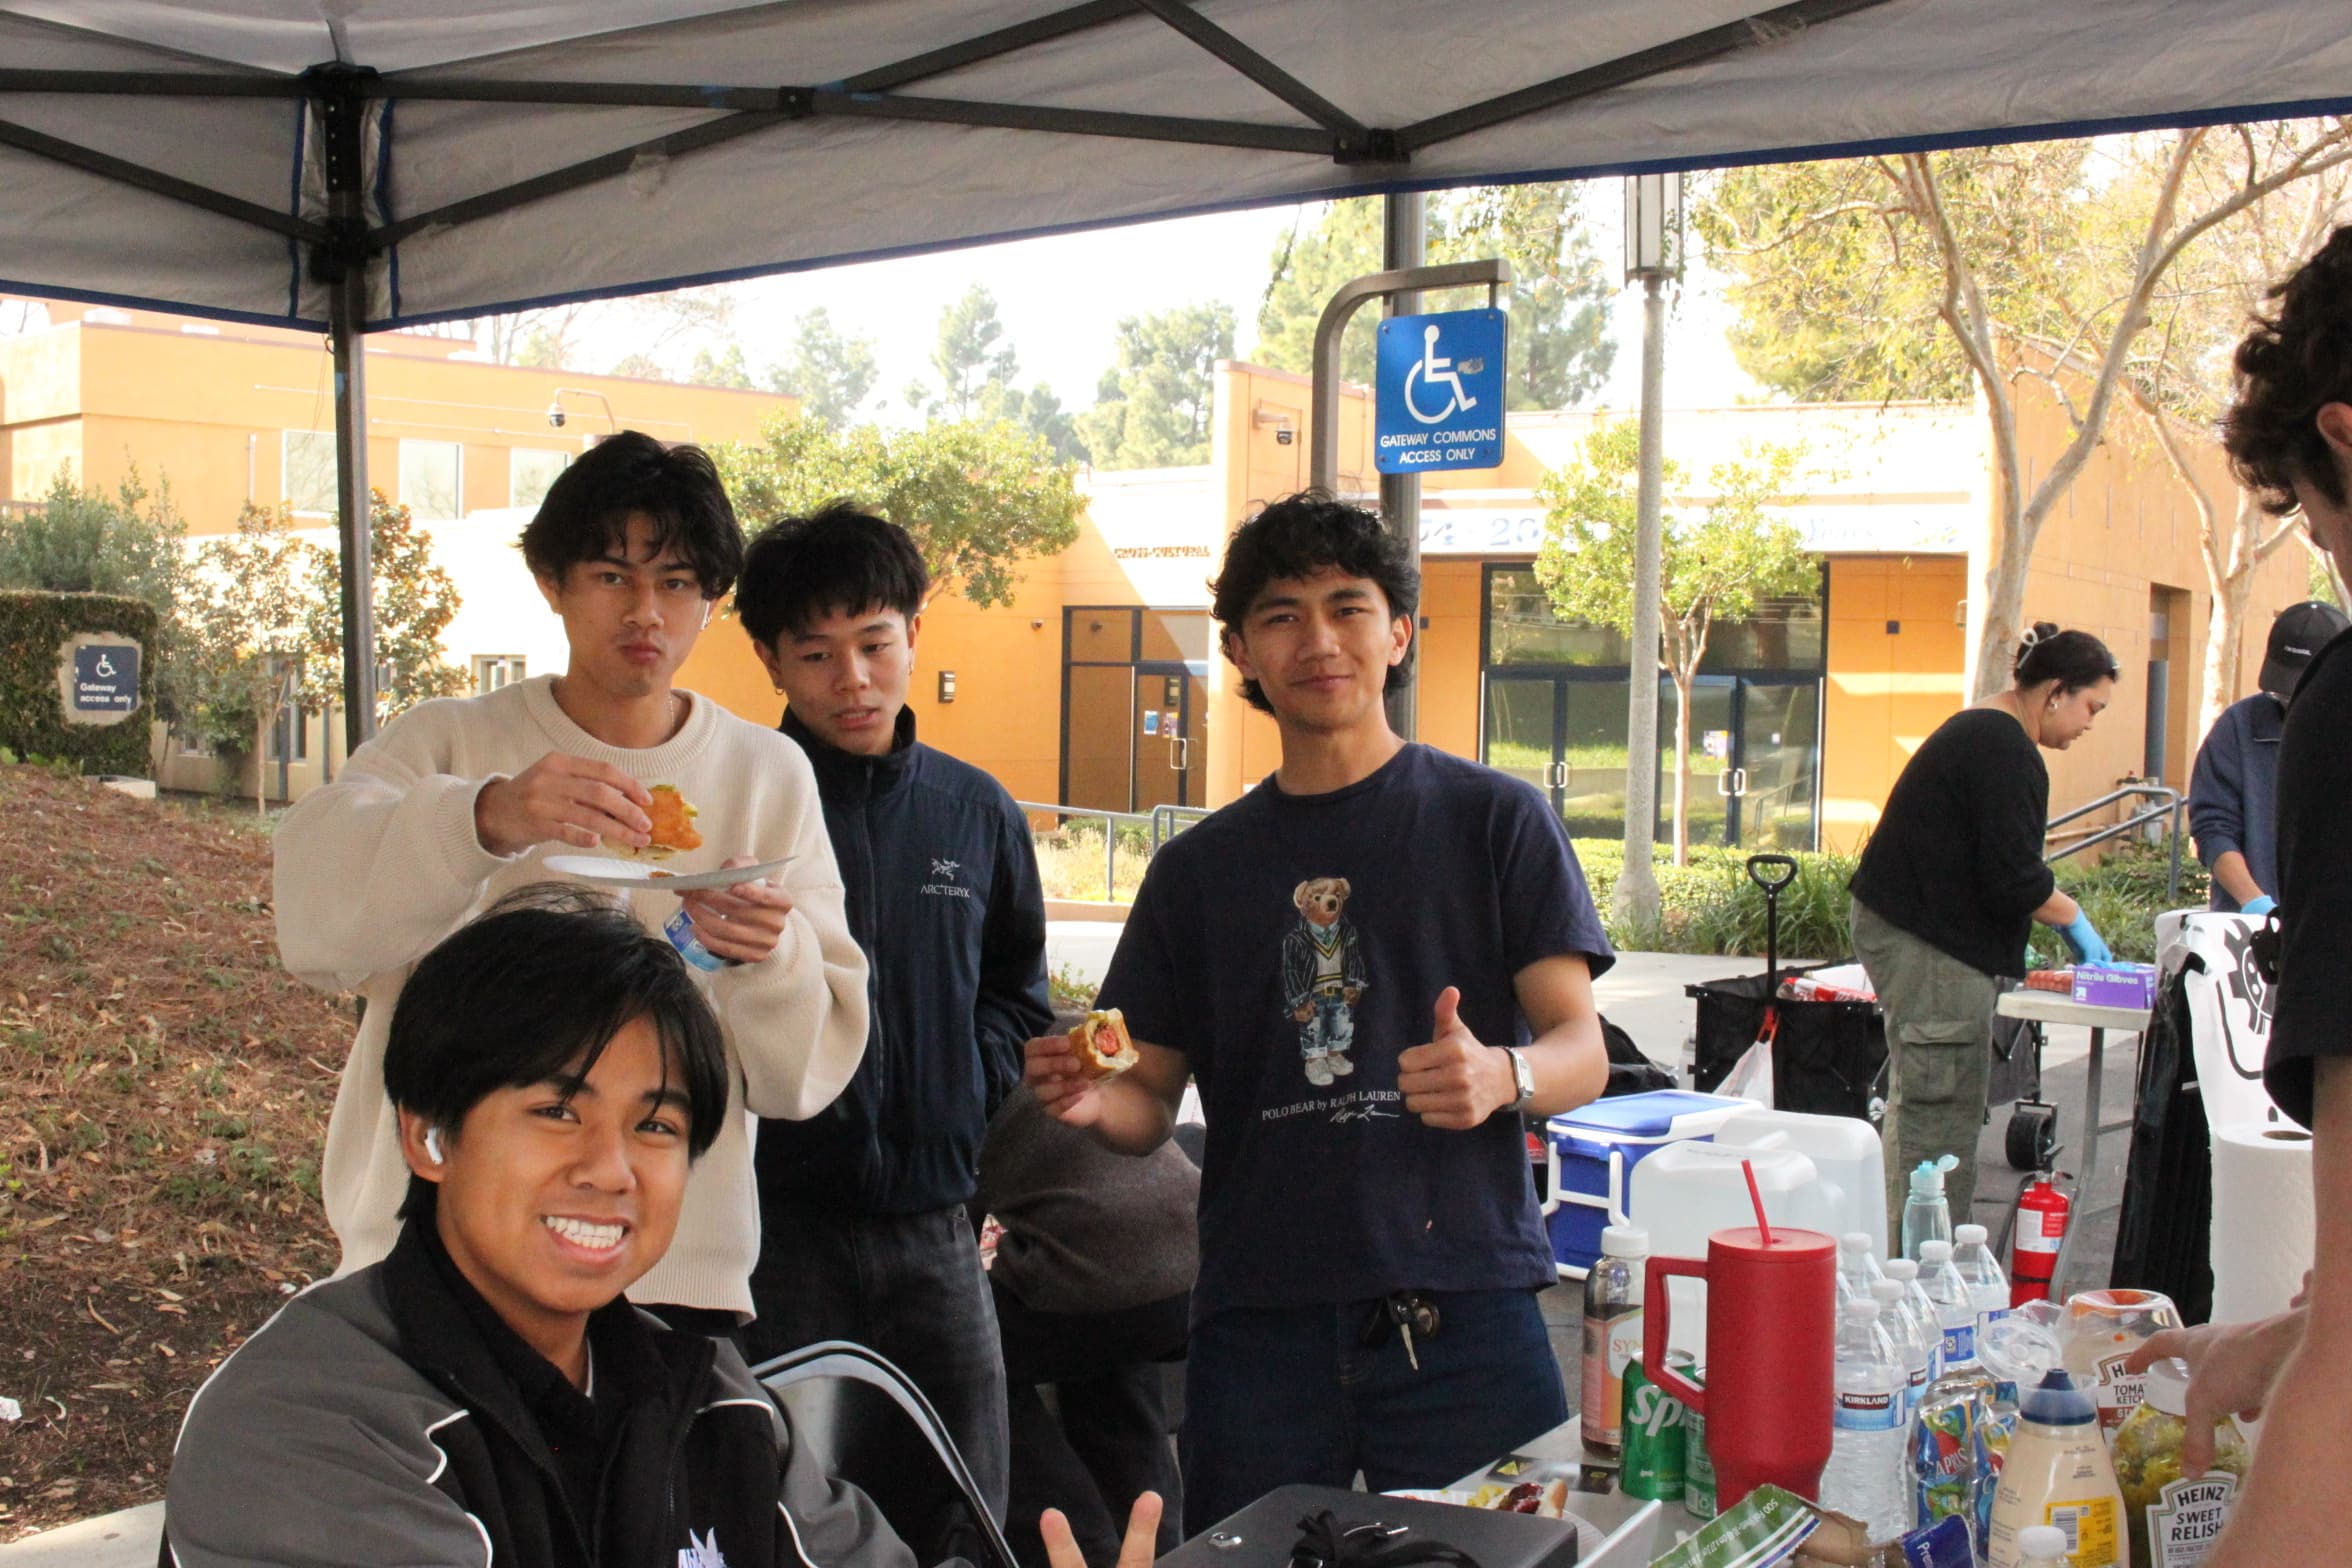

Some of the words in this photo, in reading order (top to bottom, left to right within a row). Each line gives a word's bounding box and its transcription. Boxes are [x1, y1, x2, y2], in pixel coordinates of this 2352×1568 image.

[1380, 433, 1428, 448] GATEWAY
[1433, 428, 1496, 443] COMMONS
[1399, 449, 1441, 464] ACCESS
[1446, 448, 1475, 461] ONLY
[80, 682, 116, 693] Gateway
[114, 694, 131, 705] only
[2077, 971, 2104, 982] Nitrile
[2106, 974, 2139, 985] Gloves
[1262, 1106, 1288, 1120] POLO
[1290, 1101, 1314, 1115] BEAR
[1317, 1100, 1327, 1111] by
[1359, 1090, 1400, 1102] LAUREN
[1844, 1395, 1889, 1405] KIRKLAND
[2177, 1486, 2225, 1506] HEINZ
[2176, 1507, 2222, 1525] SWEET
